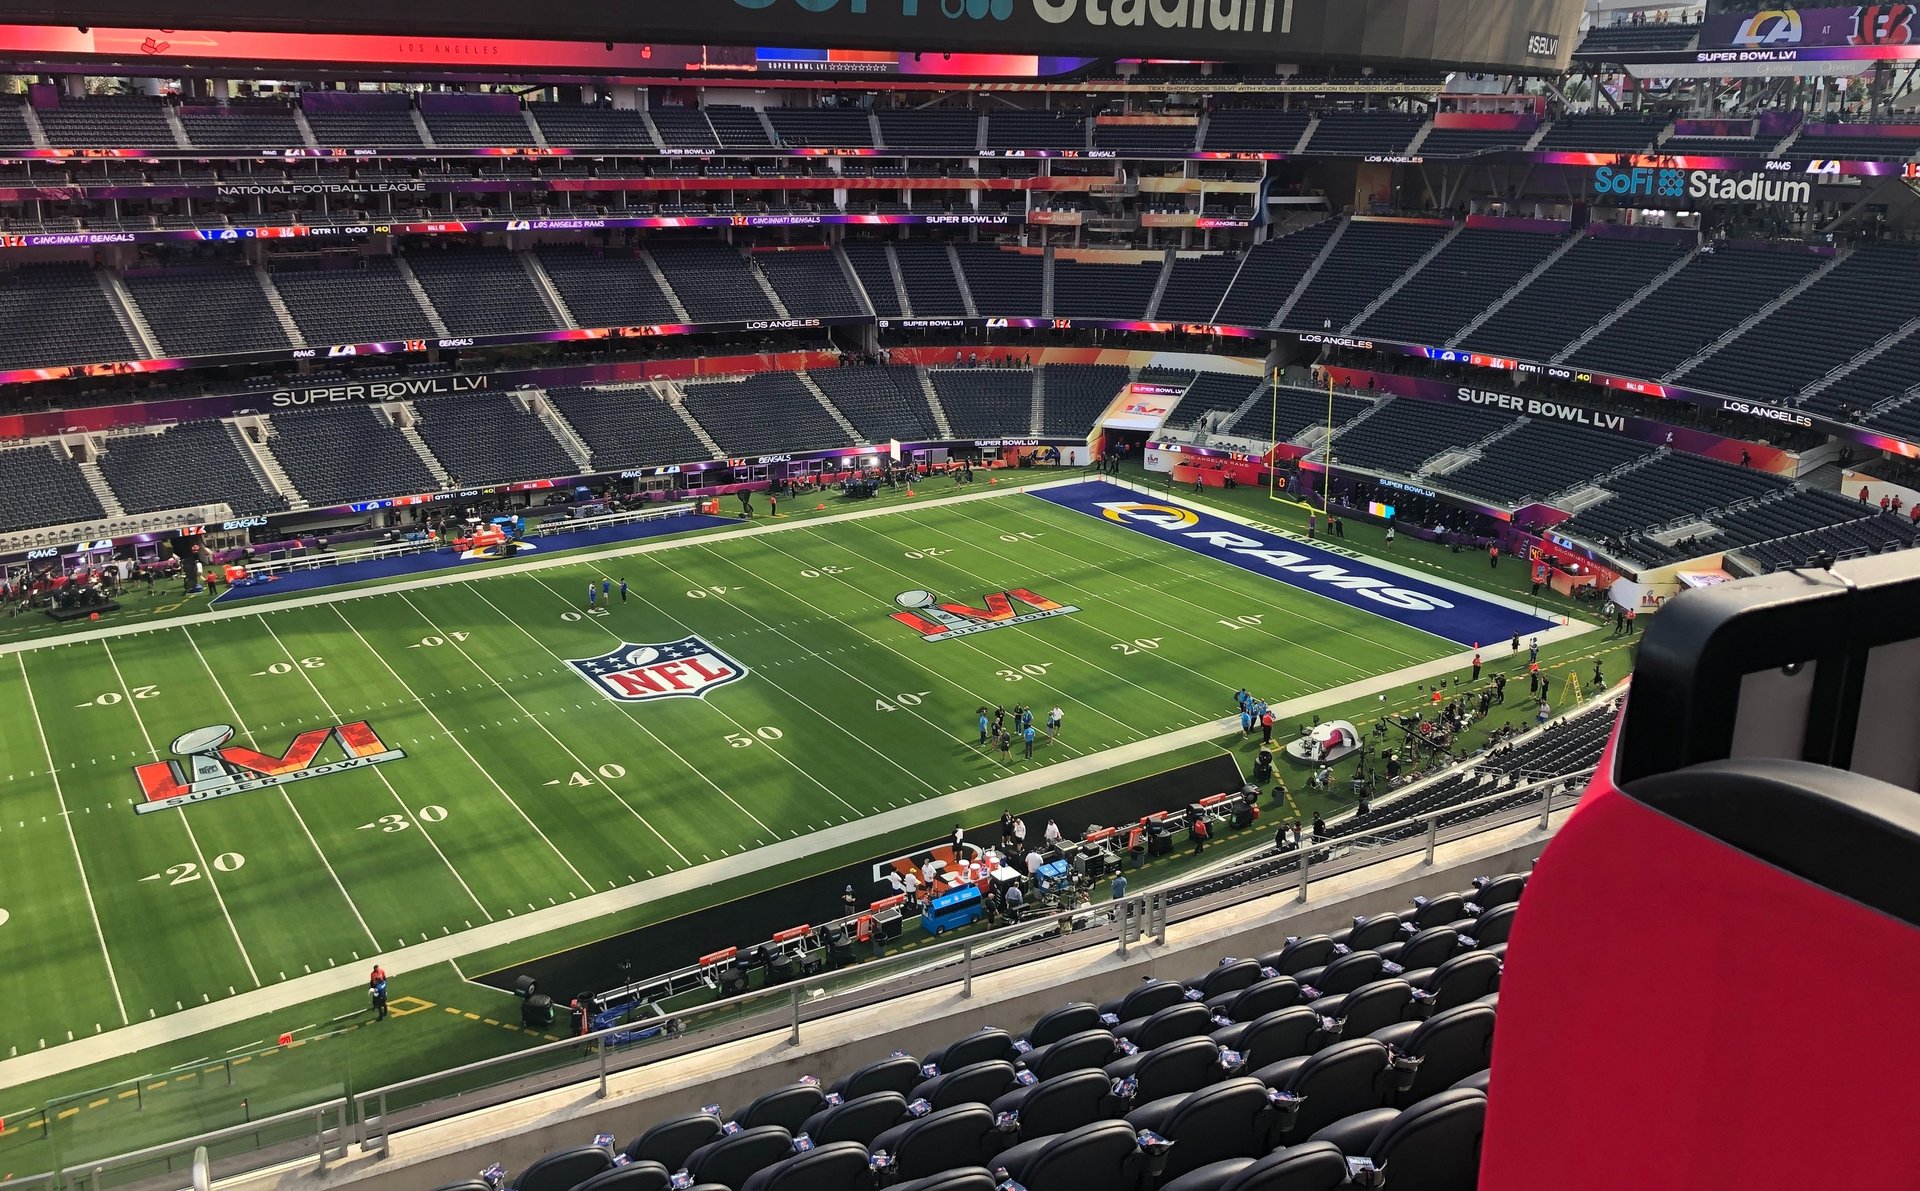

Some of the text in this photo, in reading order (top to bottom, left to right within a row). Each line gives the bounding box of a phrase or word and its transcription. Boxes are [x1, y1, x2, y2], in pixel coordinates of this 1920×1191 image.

[1821, 26, 1831, 34] AT
[399, 44, 498, 54] LOS ANGELES
[1528, 34, 1559, 56] #SBLVI
[1697, 51, 1797, 62] SUPER BOWL LVI
[1088, 150, 1116, 158] BENGALS
[1382, 156, 1424, 164] ANGELES
[1765, 161, 1792, 171] RAMS
[217, 183, 426, 195] NATIONAL FOOTBALL LEAGUE
[1594, 166, 1811, 203] SoFi Stadium
[582, 220, 605, 228] RAMS
[752, 216, 821, 225] CINCINNATI BENGALS
[926, 216, 1008, 224] SUPER BOWL LVI
[311, 228, 331, 236] QTR
[345, 226, 368, 234] 0:00
[33, 234, 135, 245] CINCINNATI BENGALS
[747, 319, 820, 329] LOS ANGELES
[439, 338, 474, 347] BENGALS
[1299, 334, 1373, 349] LOS ANGELES
[293, 349, 316, 358] RAMS
[1519, 363, 1536, 373] QTR
[1548, 368, 1570, 378] 0:00
[1577, 373, 1590, 381] 40
[272, 375, 488, 407] SUPER BOWL LVI
[1457, 387, 1624, 431] SUPER BOWL LVI
[1723, 400, 1812, 427] LOS ANGELES
[758, 453, 792, 465] BENGALS
[621, 470, 642, 479] RAMS
[1279, 477, 1286, 488] 0
[1379, 478, 1436, 499] SUPER BOWL LVI
[460, 490, 478, 498] 0:00
[224, 517, 268, 530] BENGALS
[1000, 531, 1037, 543] 10
[1246, 522, 1364, 559] END RACISM
[27, 547, 58, 560] RAMS
[905, 547, 946, 560] 20
[800, 565, 844, 578] 30
[1181, 531, 1455, 611] RAMS
[687, 586, 727, 599] 40
[560, 606, 611, 622] 50
[940, 609, 1066, 638] SUPER BOWL
[1216, 614, 1262, 631] 10
[421, 630, 471, 647] 40
[1110, 638, 1160, 655] 20
[268, 656, 326, 674] 30
[606, 657, 732, 696] NFL
[995, 663, 1047, 682] 30
[97, 685, 161, 706] 20
[875, 692, 922, 713] 40
[723, 726, 783, 749] 50
[165, 755, 381, 807] SUPER BOWL
[568, 763, 626, 788] 40
[378, 805, 449, 833] 30
[165, 852, 246, 886] 20
